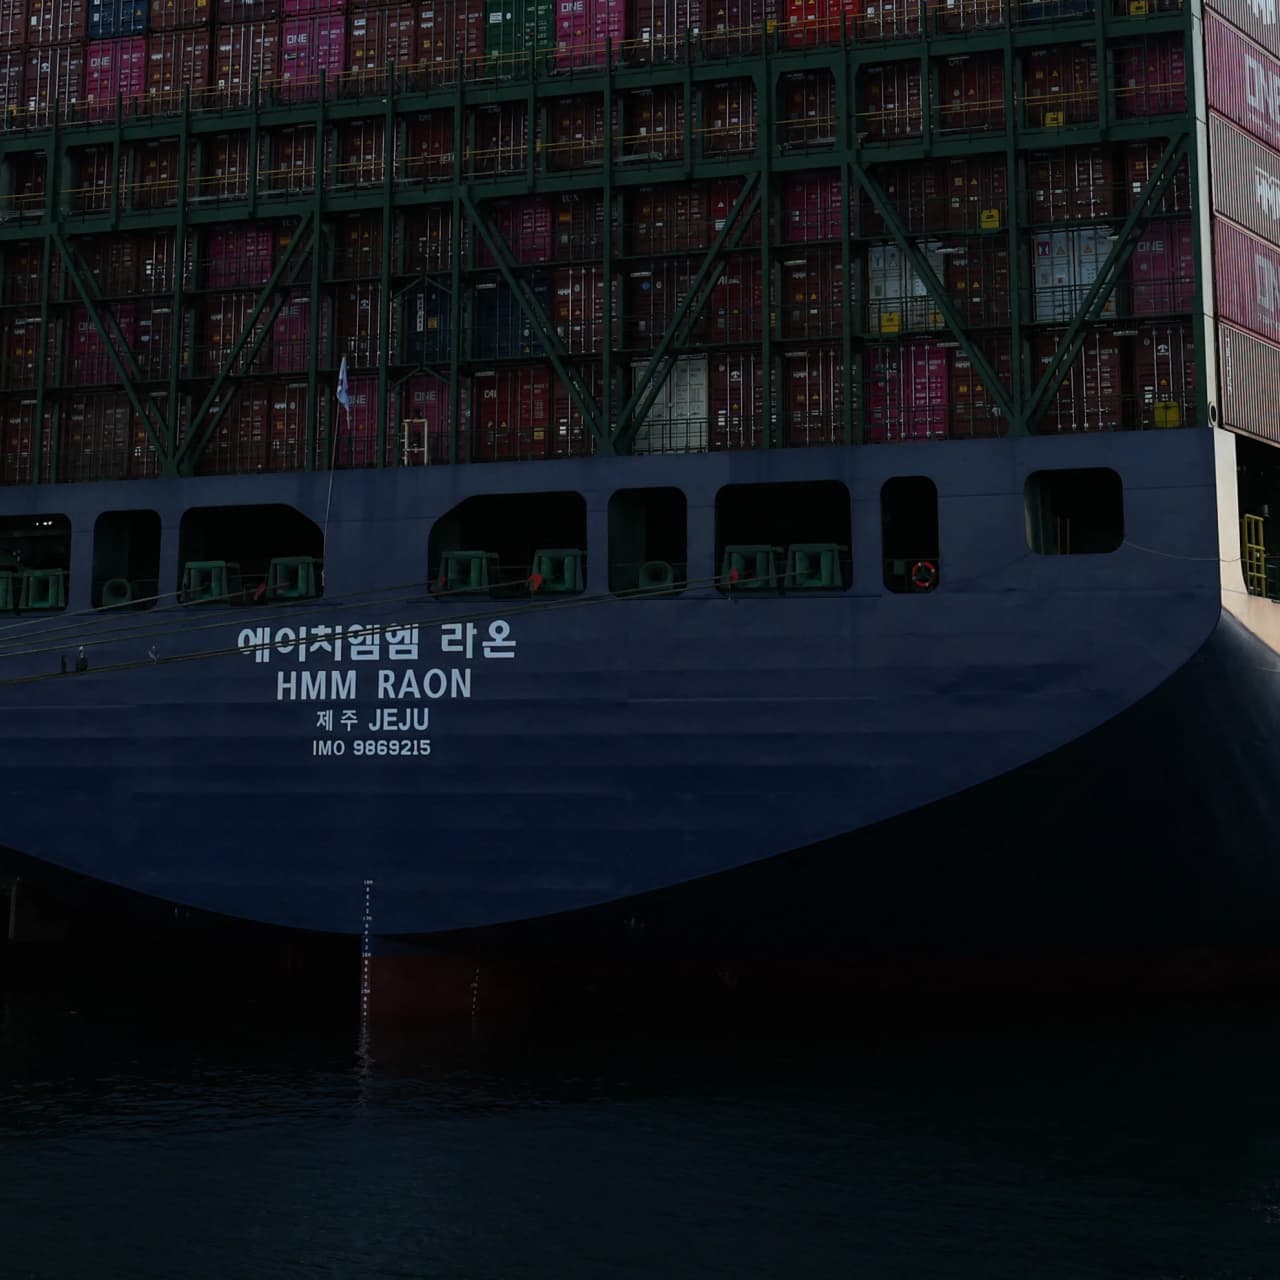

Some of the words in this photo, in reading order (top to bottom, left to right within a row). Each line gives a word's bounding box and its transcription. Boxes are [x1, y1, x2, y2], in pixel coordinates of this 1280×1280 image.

[561, 0, 584, 12] ONE
[287, 33, 308, 44] ONE
[91, 56, 110, 66] ONE
[1137, 240, 1163, 252] ONE
[414, 391, 436, 401] ONE
[237, 623, 419, 663] 에이치엠엠
[441, 620, 516, 659] 라온
[277, 670, 357, 701] HMM
[378, 668, 471, 699] RAON
[369, 708, 429, 731] JEJU
[313, 740, 345, 755] IMO
[353, 739, 431, 755] 9869215
